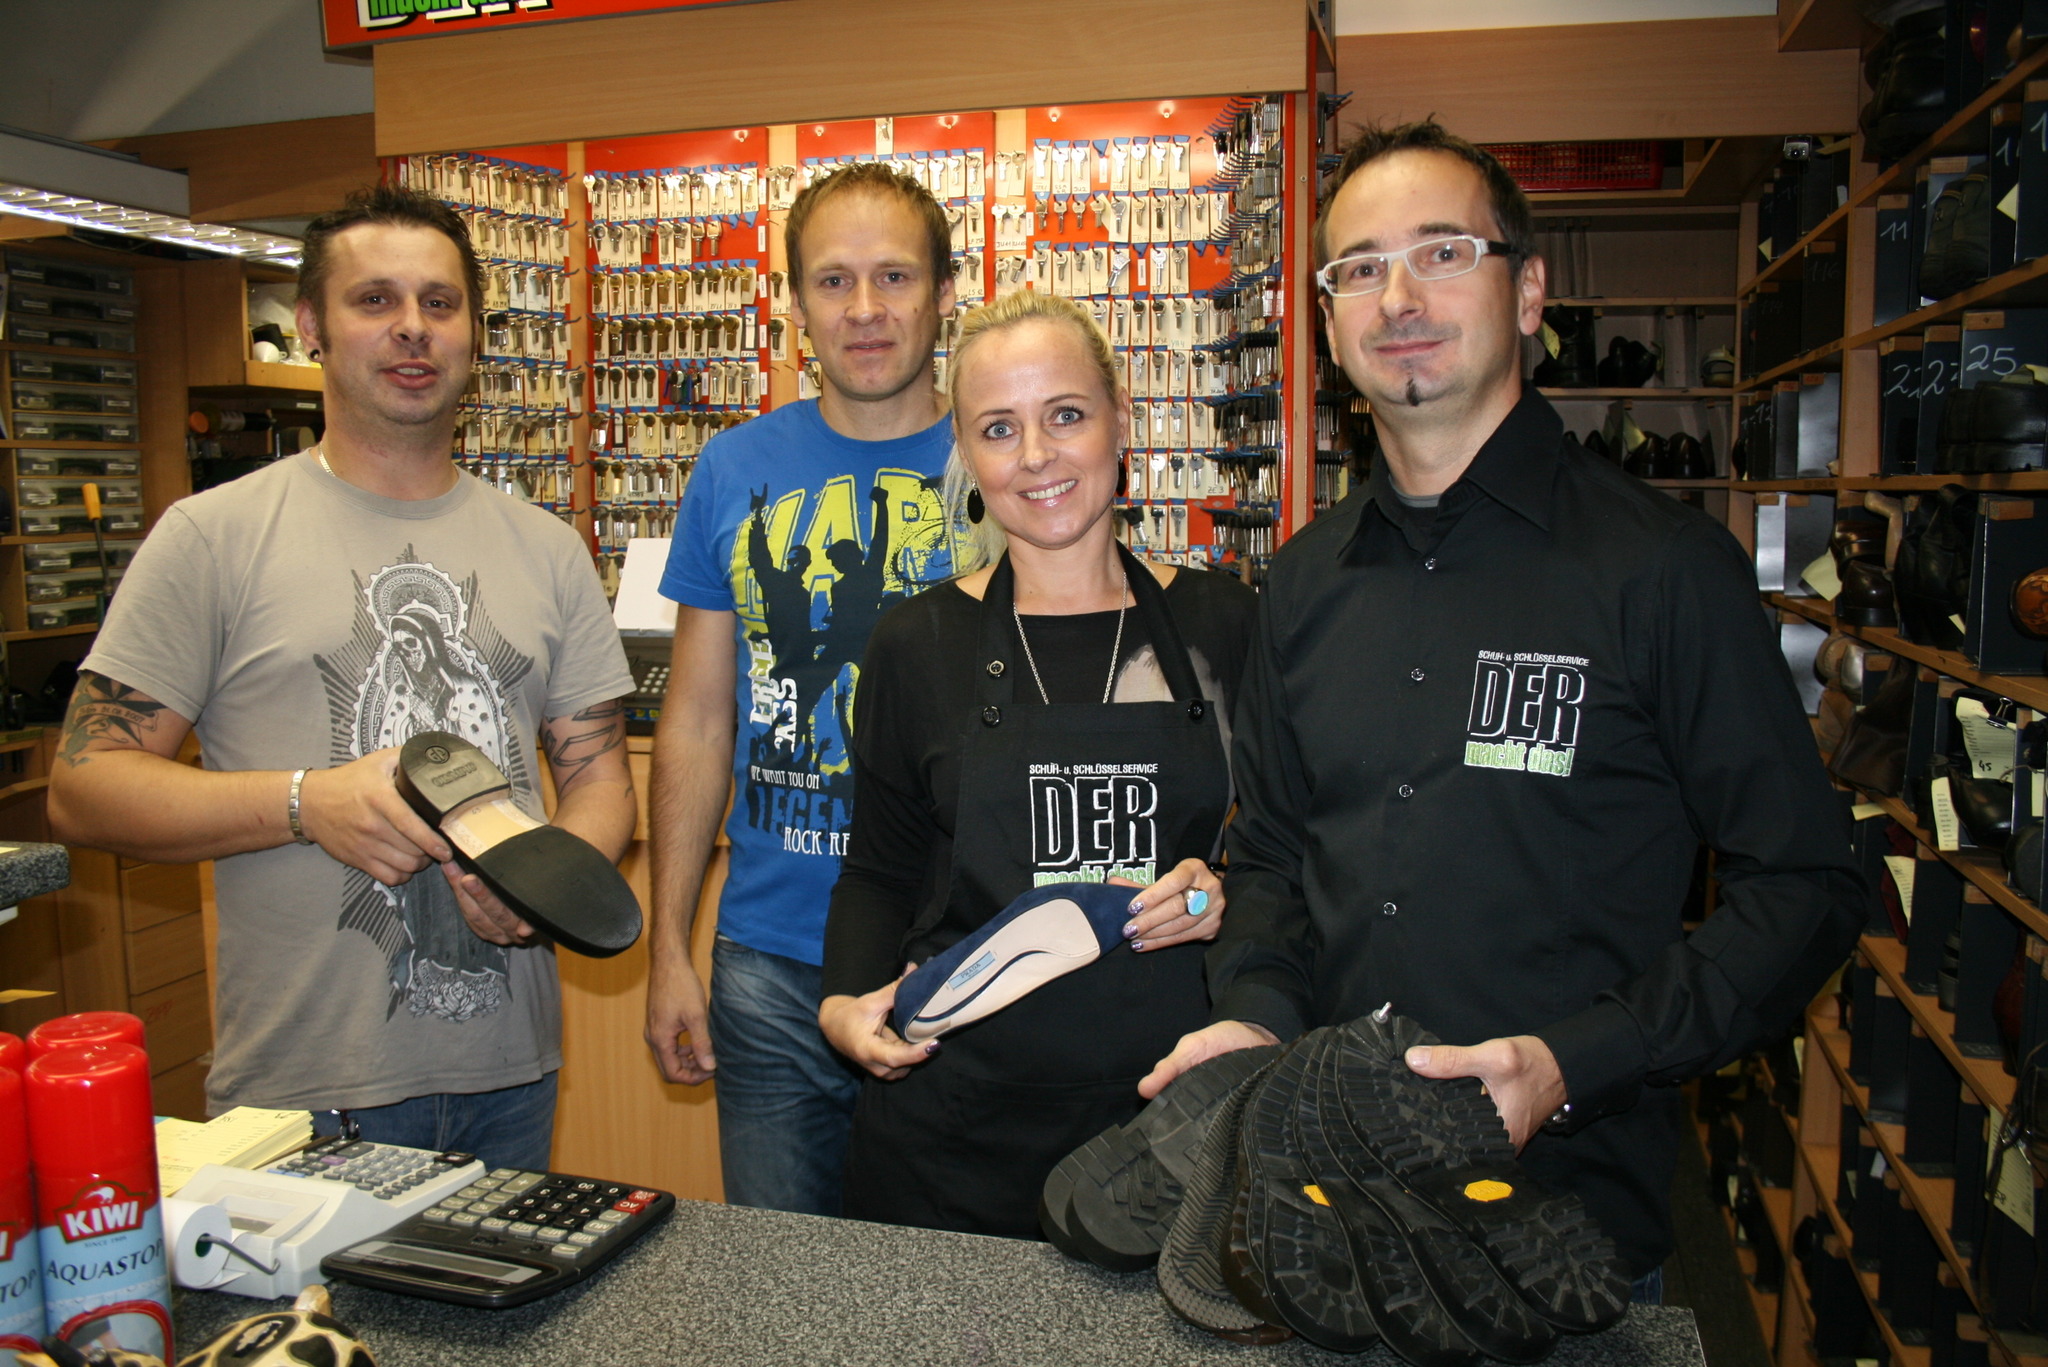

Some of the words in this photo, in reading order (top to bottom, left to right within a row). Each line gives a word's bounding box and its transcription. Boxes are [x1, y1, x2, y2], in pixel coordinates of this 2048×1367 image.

[1966, 344, 2017, 376] 25
[1467, 660, 1585, 747] DER
[1464, 739, 1526, 771] macht
[750, 765, 761, 782] WE
[762, 768, 786, 785] WANT
[787, 770, 804, 788] YOU
[806, 773, 820, 790] ON
[1029, 775, 1158, 867] DER
[783, 826, 823, 856] ROCK
[65, 1201, 139, 1238] KIWI
[47, 1238, 163, 1286] AQUASTOP
